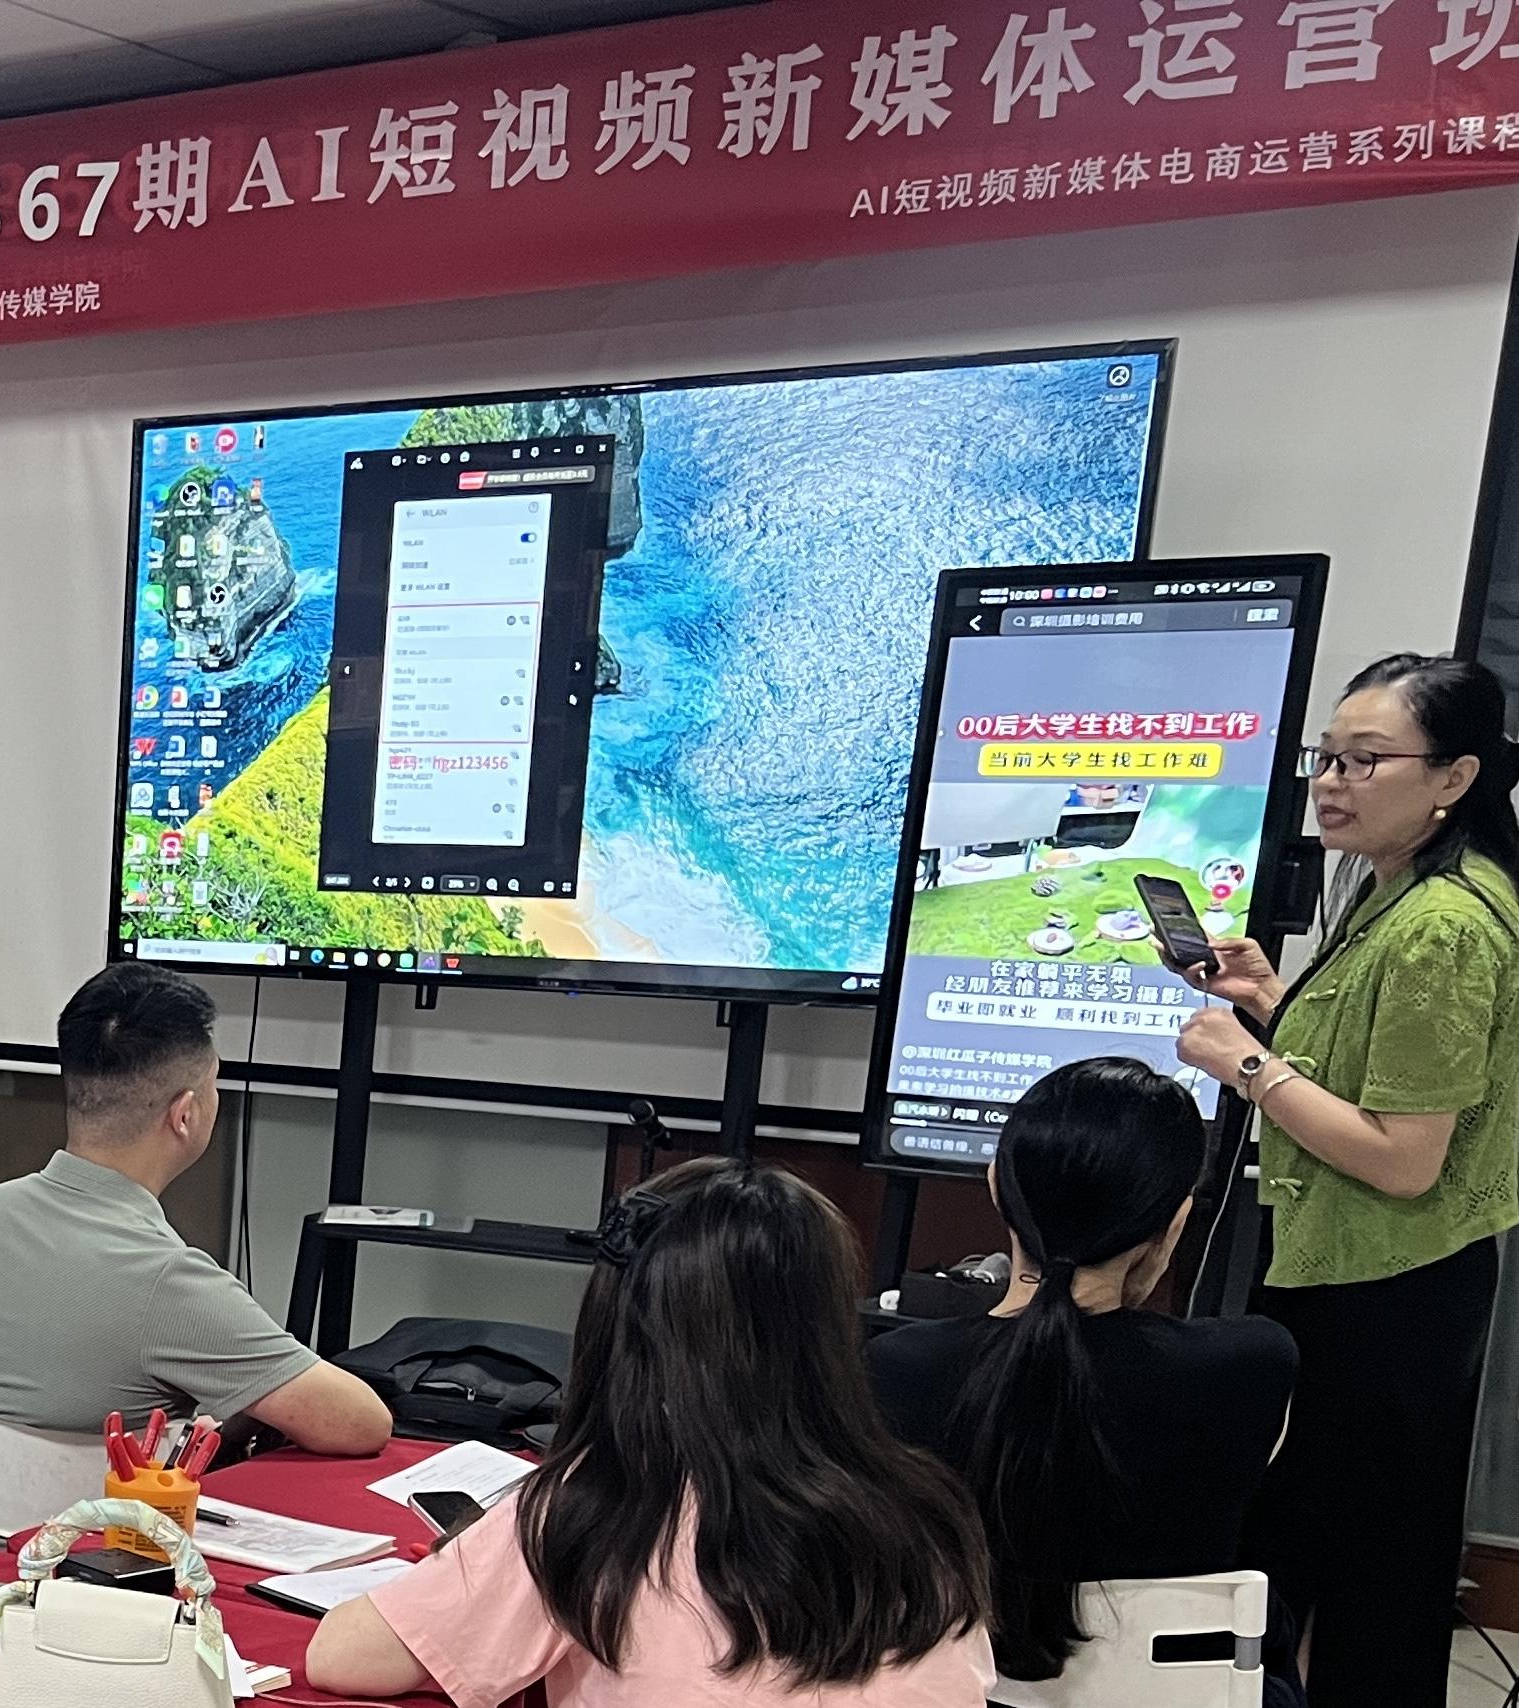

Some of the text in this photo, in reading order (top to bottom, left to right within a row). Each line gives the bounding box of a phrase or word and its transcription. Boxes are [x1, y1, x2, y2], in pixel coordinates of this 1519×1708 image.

[958, 711, 1255, 738] 00后大学生找不到工作
[989, 751, 1208, 769] 当前大学生找工作难
[990, 959, 1133, 985] 在家躺平无果
[944, 975, 1185, 1005] 经朋友推荐来学习摄影
[936, 999, 1037, 1020] 毕业即就业
